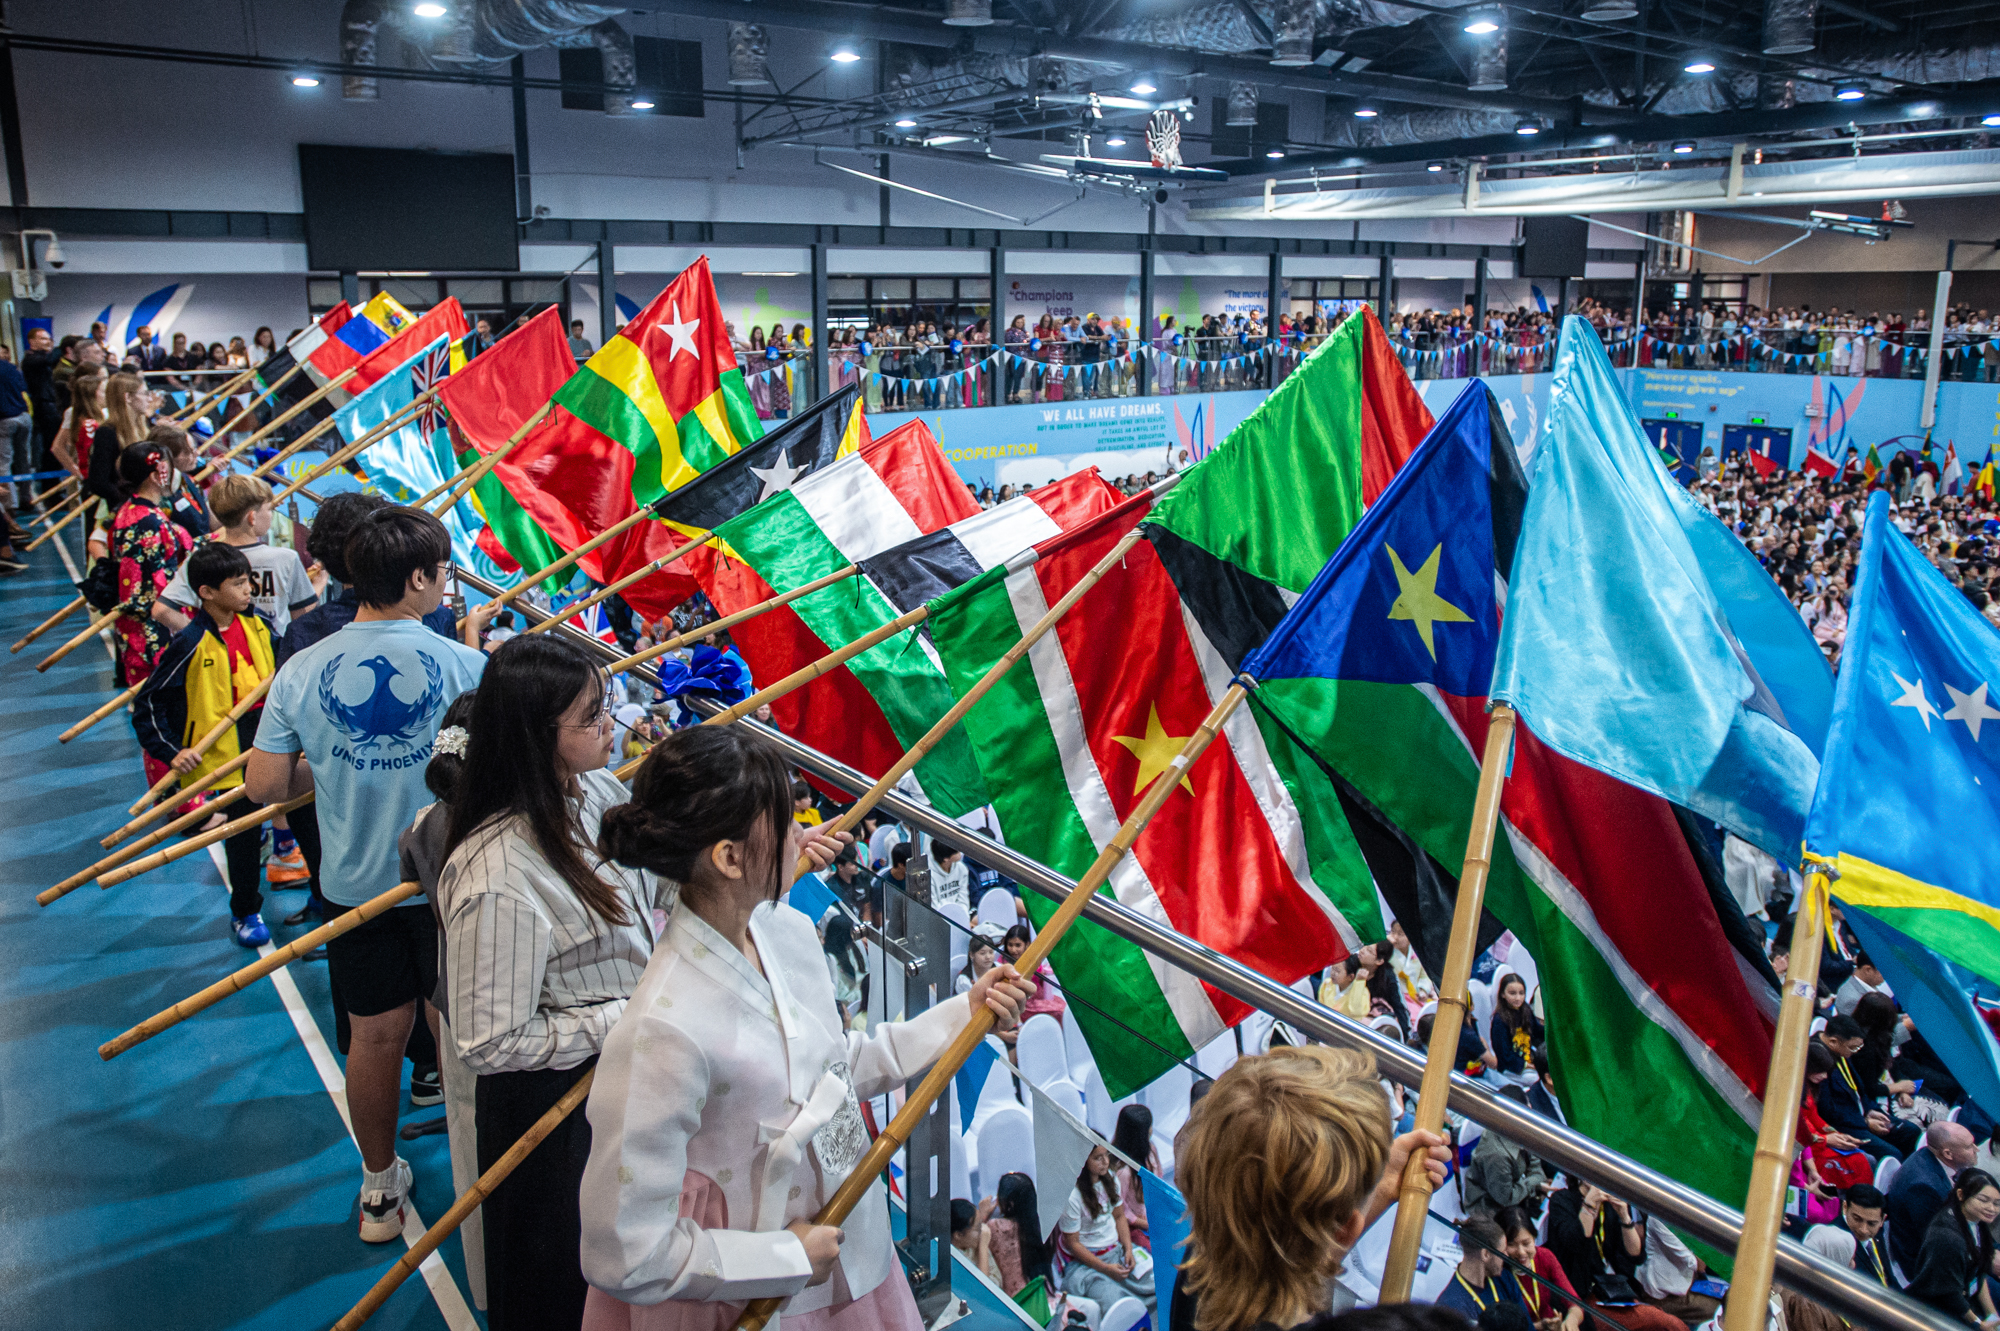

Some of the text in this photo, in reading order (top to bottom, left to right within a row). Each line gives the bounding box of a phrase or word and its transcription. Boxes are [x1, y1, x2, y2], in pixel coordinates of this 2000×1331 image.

[1242, 290, 1260, 298] more
[1046, 305, 1073, 318] keep
[1225, 304, 1236, 312] the
[1065, 408, 1085, 421] ALL
[1089, 406, 1116, 419] HAVE
[250, 571, 275, 597] SA
[331, 740, 434, 771] UNIS PHOENIX
